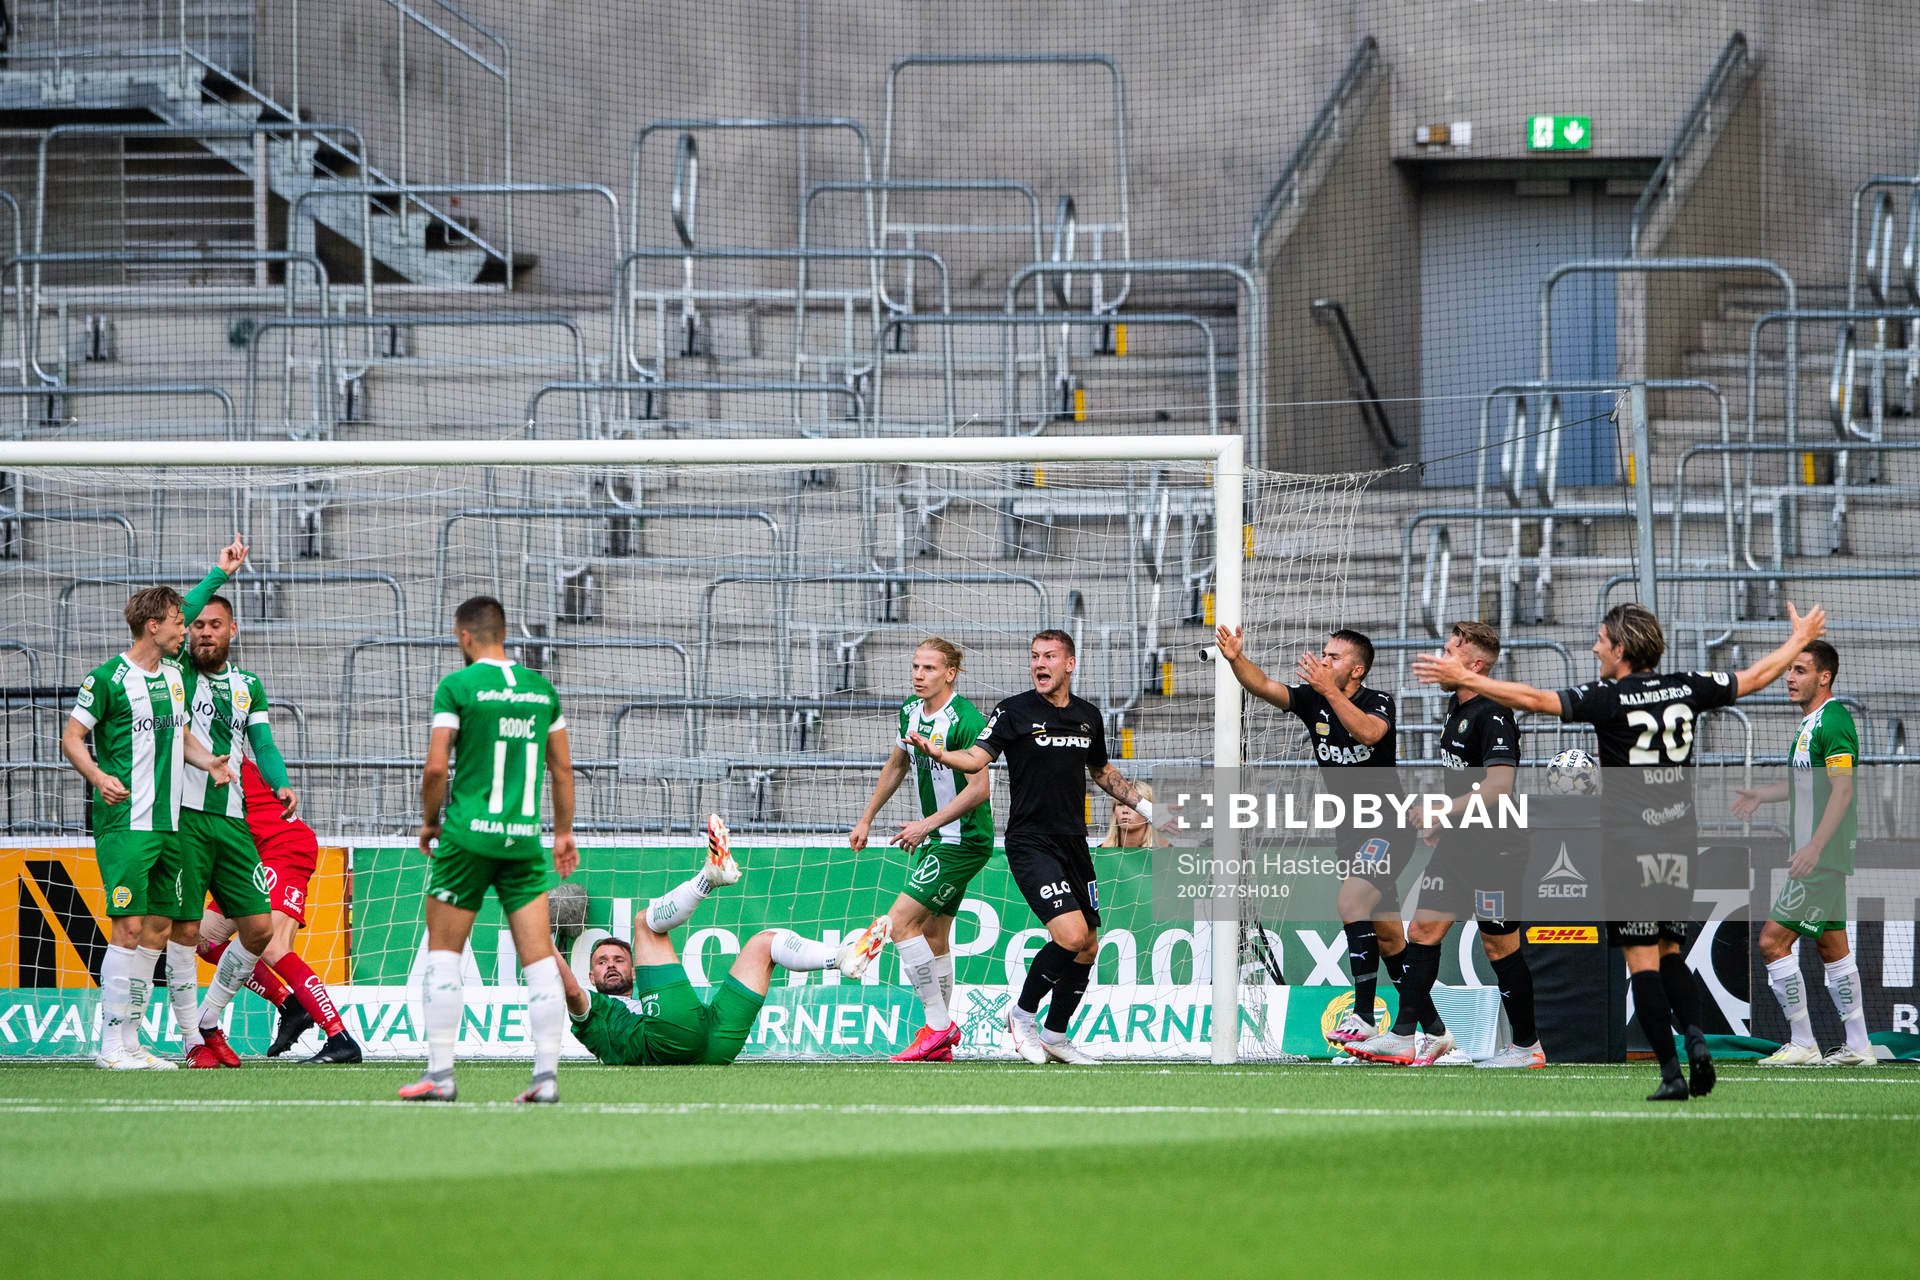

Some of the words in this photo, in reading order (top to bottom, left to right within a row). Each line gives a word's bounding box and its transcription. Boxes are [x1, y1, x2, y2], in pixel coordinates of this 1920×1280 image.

[499, 715, 536, 739] RODIĆ
[1626, 703, 1694, 766] 20
[1441, 748, 1464, 771] BAB
[488, 740, 539, 816] 11
[1643, 766, 1684, 784] BOOK
[470, 818, 504, 835] SILJA
[1538, 884, 1588, 898] SELECT
[1053, 899, 1063, 909] 27
[1536, 929, 1589, 940] DHL
